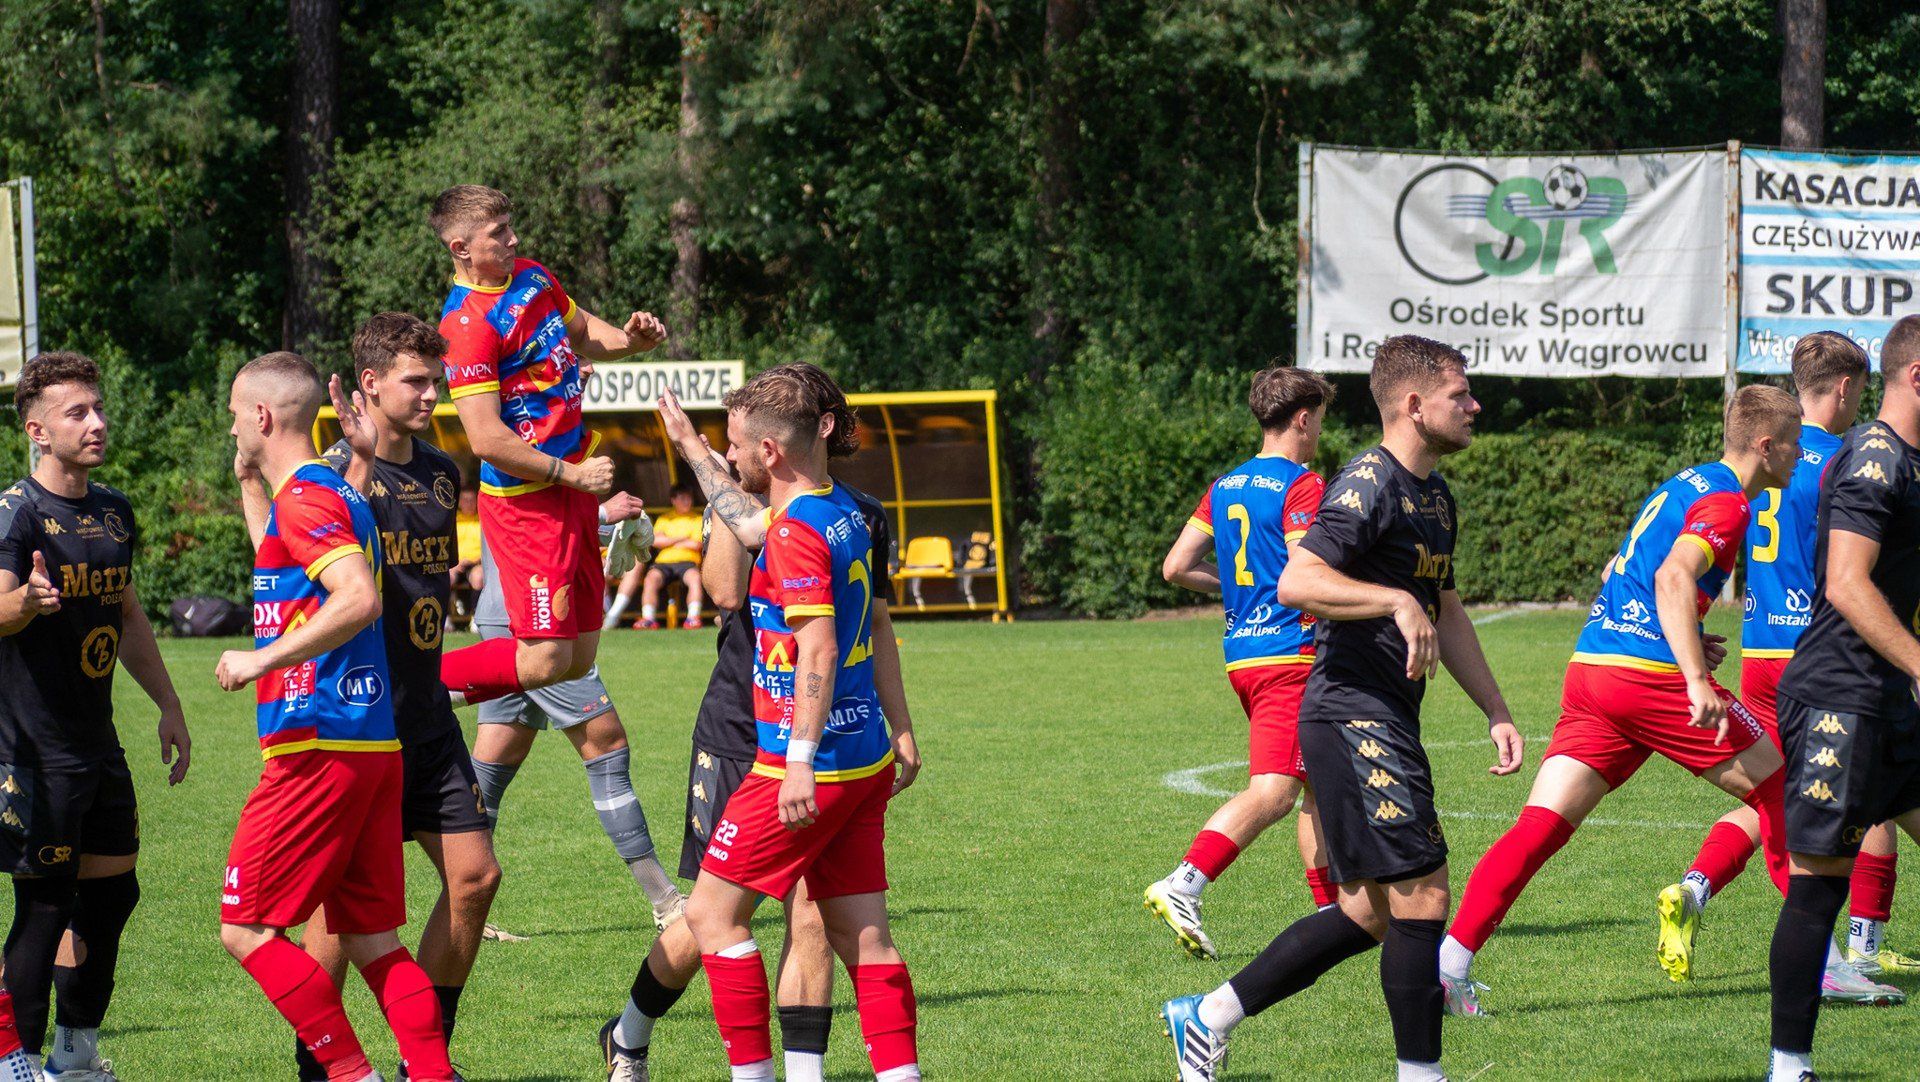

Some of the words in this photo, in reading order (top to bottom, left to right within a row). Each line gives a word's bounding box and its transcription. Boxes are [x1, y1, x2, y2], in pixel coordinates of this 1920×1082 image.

[1755, 169, 1920, 207] KASACJA
[1752, 219, 1832, 252] CZĘŚCI
[1766, 273, 1913, 316] SKUP
[1390, 297, 1528, 327] Ośrodek
[1540, 301, 1644, 332] Sportu
[1324, 332, 1330, 357] i
[1342, 333, 1489, 367] Recji
[1501, 345, 1527, 362] w
[1538, 339, 1707, 369] Wągrowcu
[587, 367, 731, 404] OSPODARZE
[1752, 487, 1781, 563] 3
[382, 531, 449, 566] Merx
[1227, 503, 1254, 586] 2
[60, 562, 129, 598] Merx
[529, 574, 551, 631] JENOX
[715, 819, 739, 846] 22
[225, 865, 239, 889] 14
[222, 894, 240, 905] AKO
